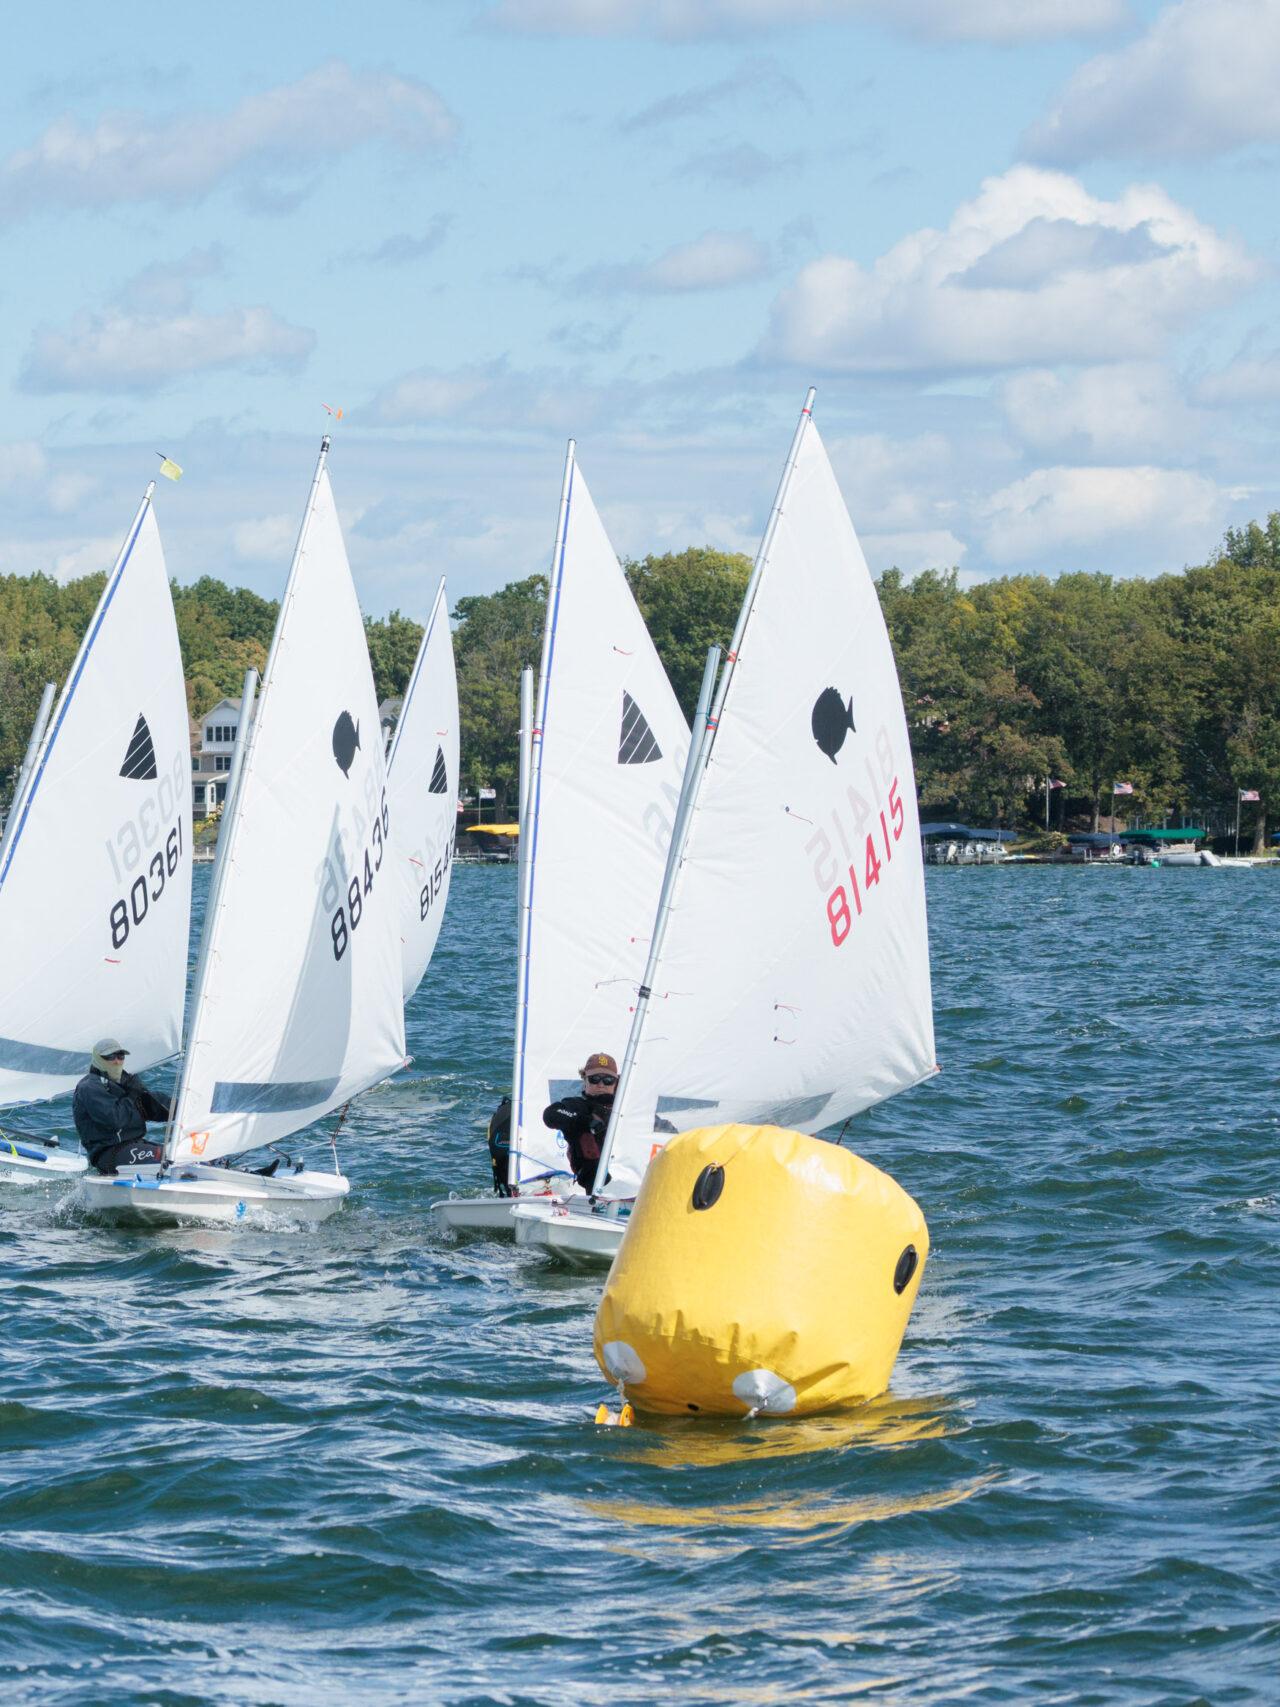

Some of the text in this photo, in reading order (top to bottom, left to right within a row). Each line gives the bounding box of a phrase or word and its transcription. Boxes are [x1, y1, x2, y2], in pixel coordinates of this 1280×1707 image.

[110, 815, 183, 950] 80361
[331, 785, 389, 961] 88436
[827, 776, 904, 947] 81415
[129, 1147, 155, 1164] Sea
